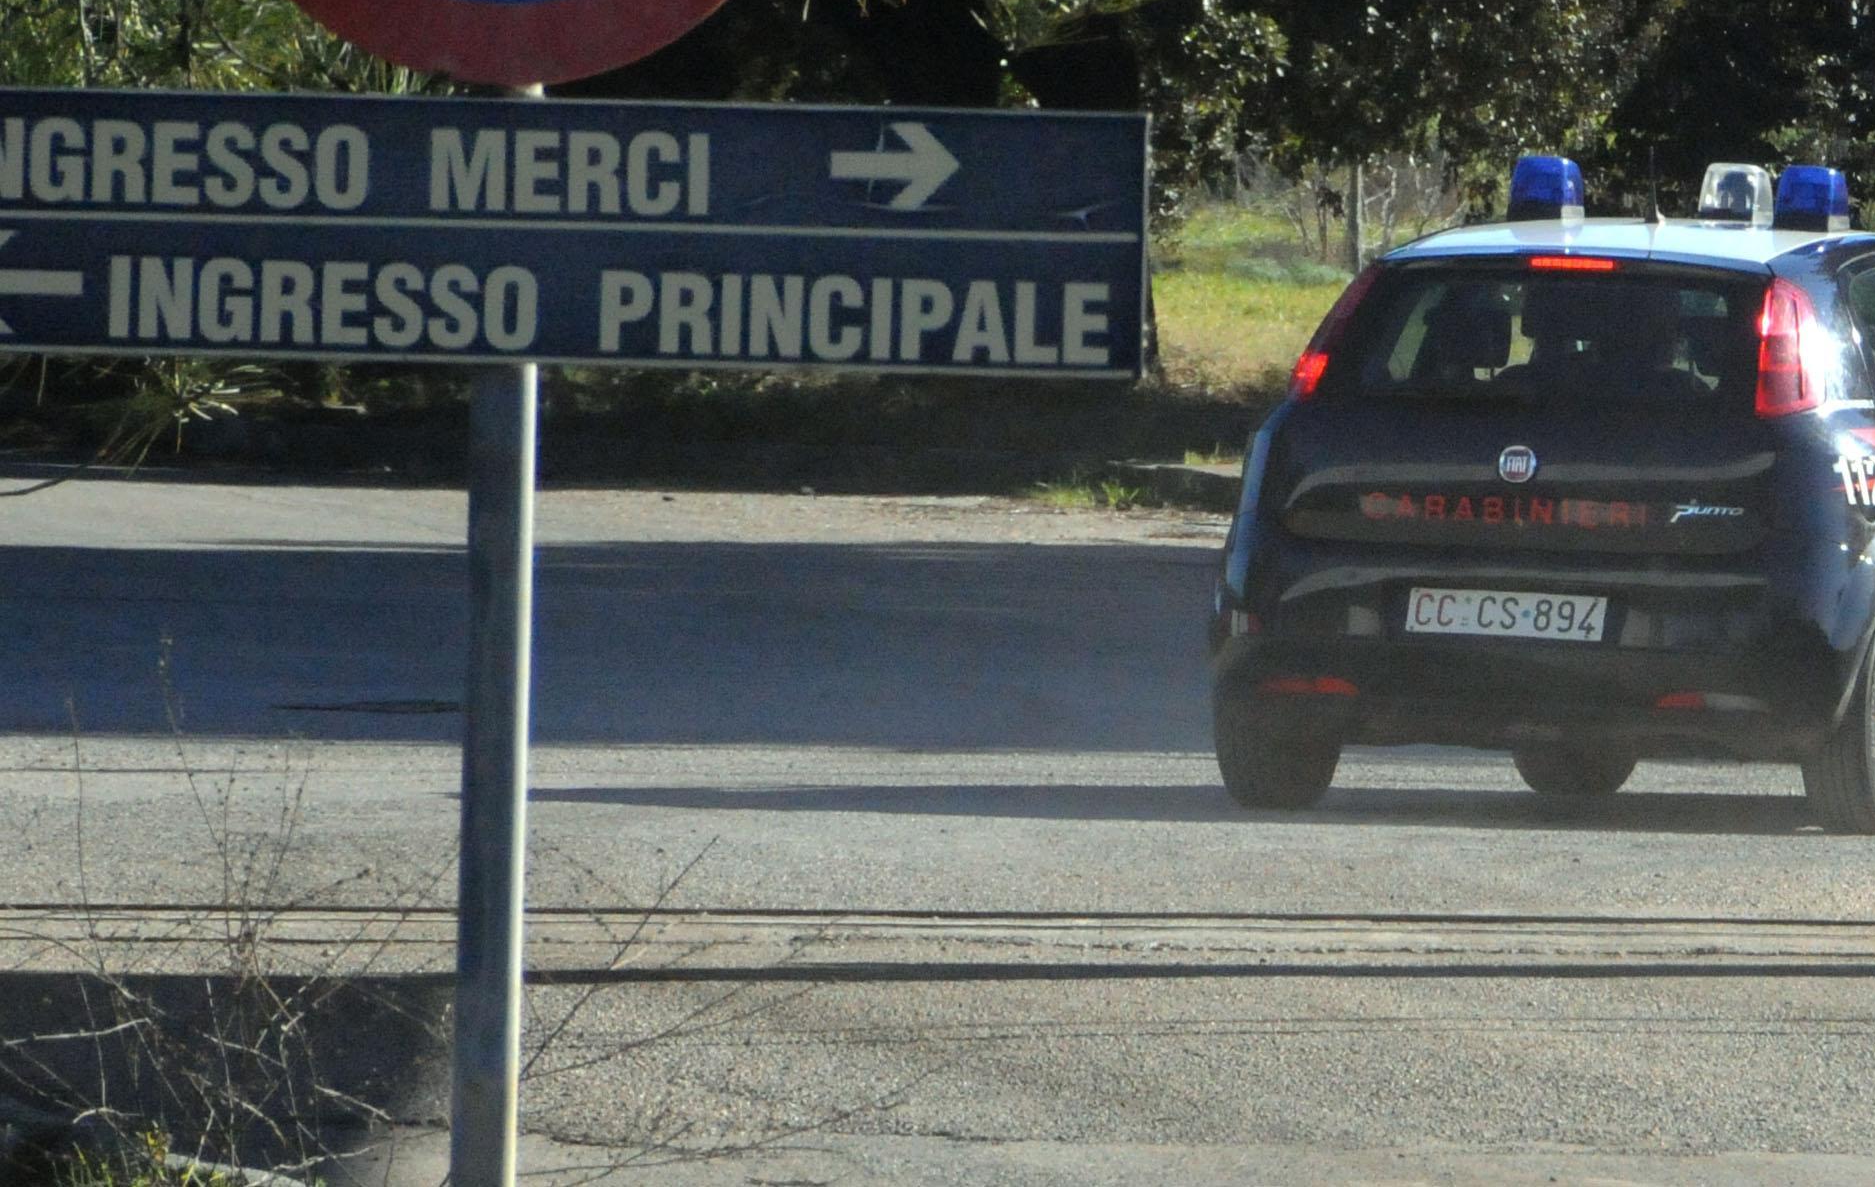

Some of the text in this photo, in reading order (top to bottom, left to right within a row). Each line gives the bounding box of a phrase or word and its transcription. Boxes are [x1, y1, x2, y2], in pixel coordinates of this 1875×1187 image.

[429, 127, 710, 216] MERCI
[107, 254, 1111, 365] INGRESSO PRINCIPALE
[1506, 455, 1528, 473] FIAT
[1362, 492, 1649, 529] CARABINIERI
